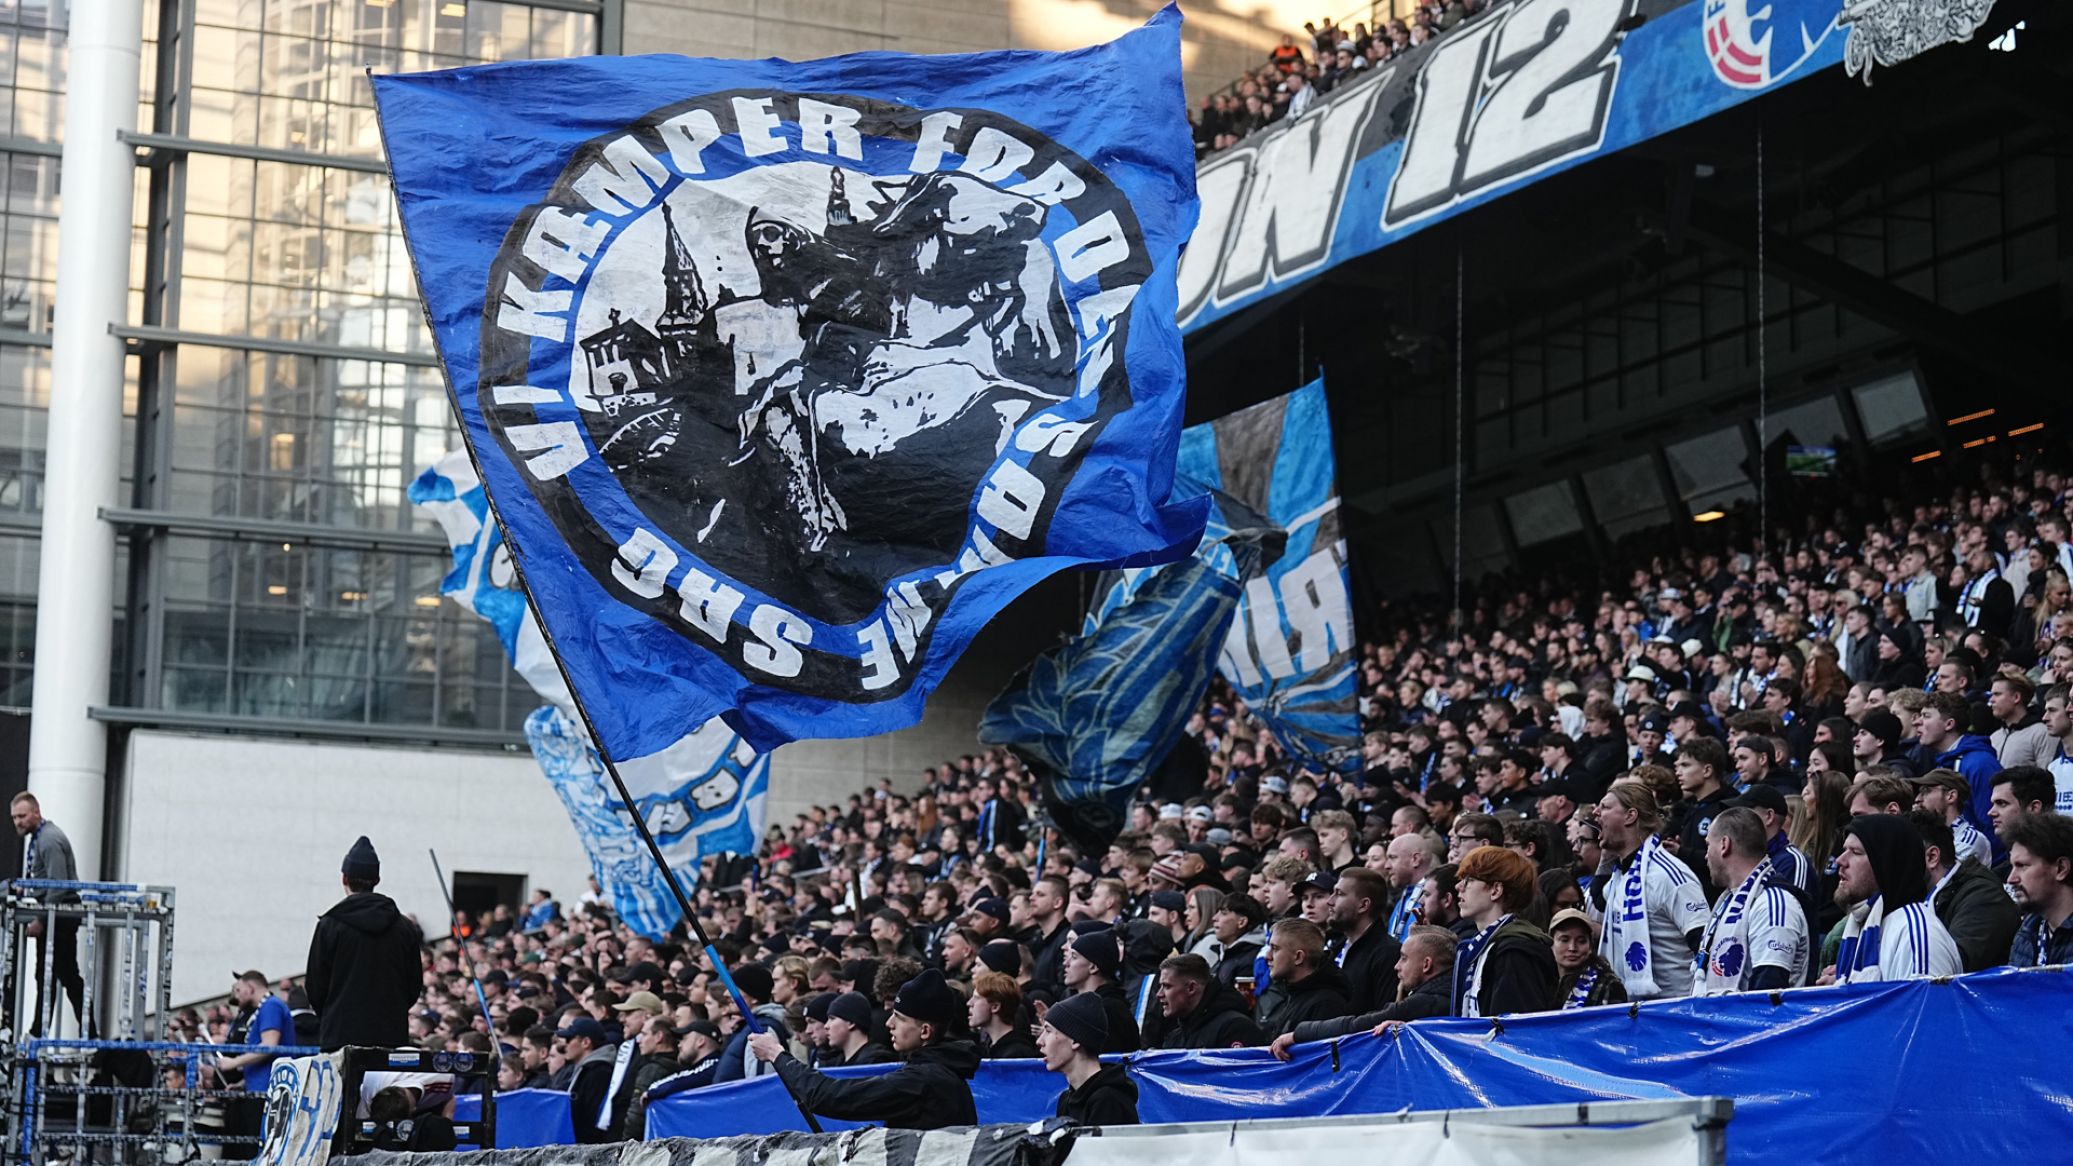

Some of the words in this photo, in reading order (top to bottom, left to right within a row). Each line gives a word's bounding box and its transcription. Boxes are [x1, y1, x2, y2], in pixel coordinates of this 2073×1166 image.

[908, 111, 1087, 206] FOR
[1382, 0, 1622, 232] 12
[497, 97, 863, 343] KÆMPER
[492, 385, 590, 481] VI
[610, 527, 813, 678] SAG
